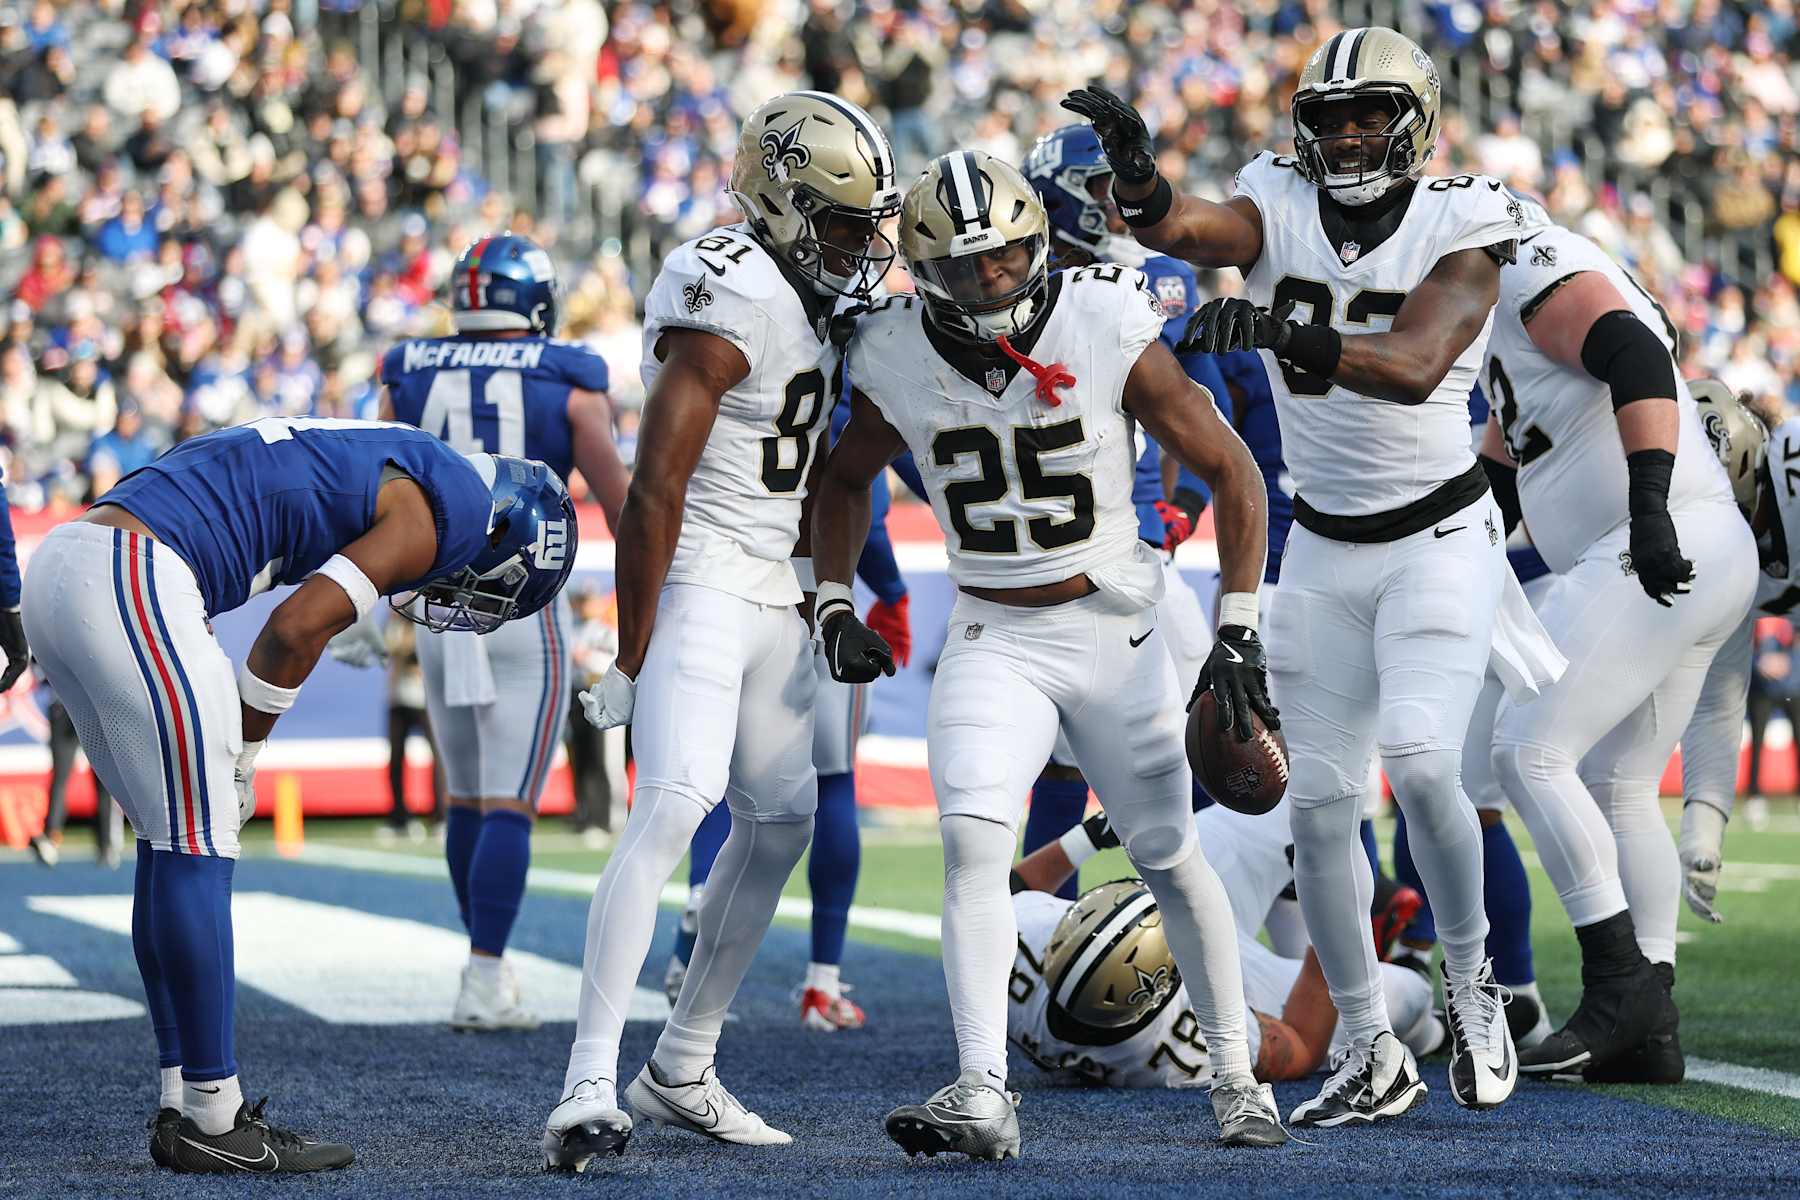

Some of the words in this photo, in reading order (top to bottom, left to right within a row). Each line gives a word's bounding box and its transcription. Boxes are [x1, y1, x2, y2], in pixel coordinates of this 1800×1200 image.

[695, 235, 752, 264] 81
[963, 233, 989, 246] SAINTS
[403, 340, 545, 374] McFADDEN
[420, 368, 526, 460] 41
[931, 415, 1097, 555] 25
[1148, 1009, 1208, 1080] 78
